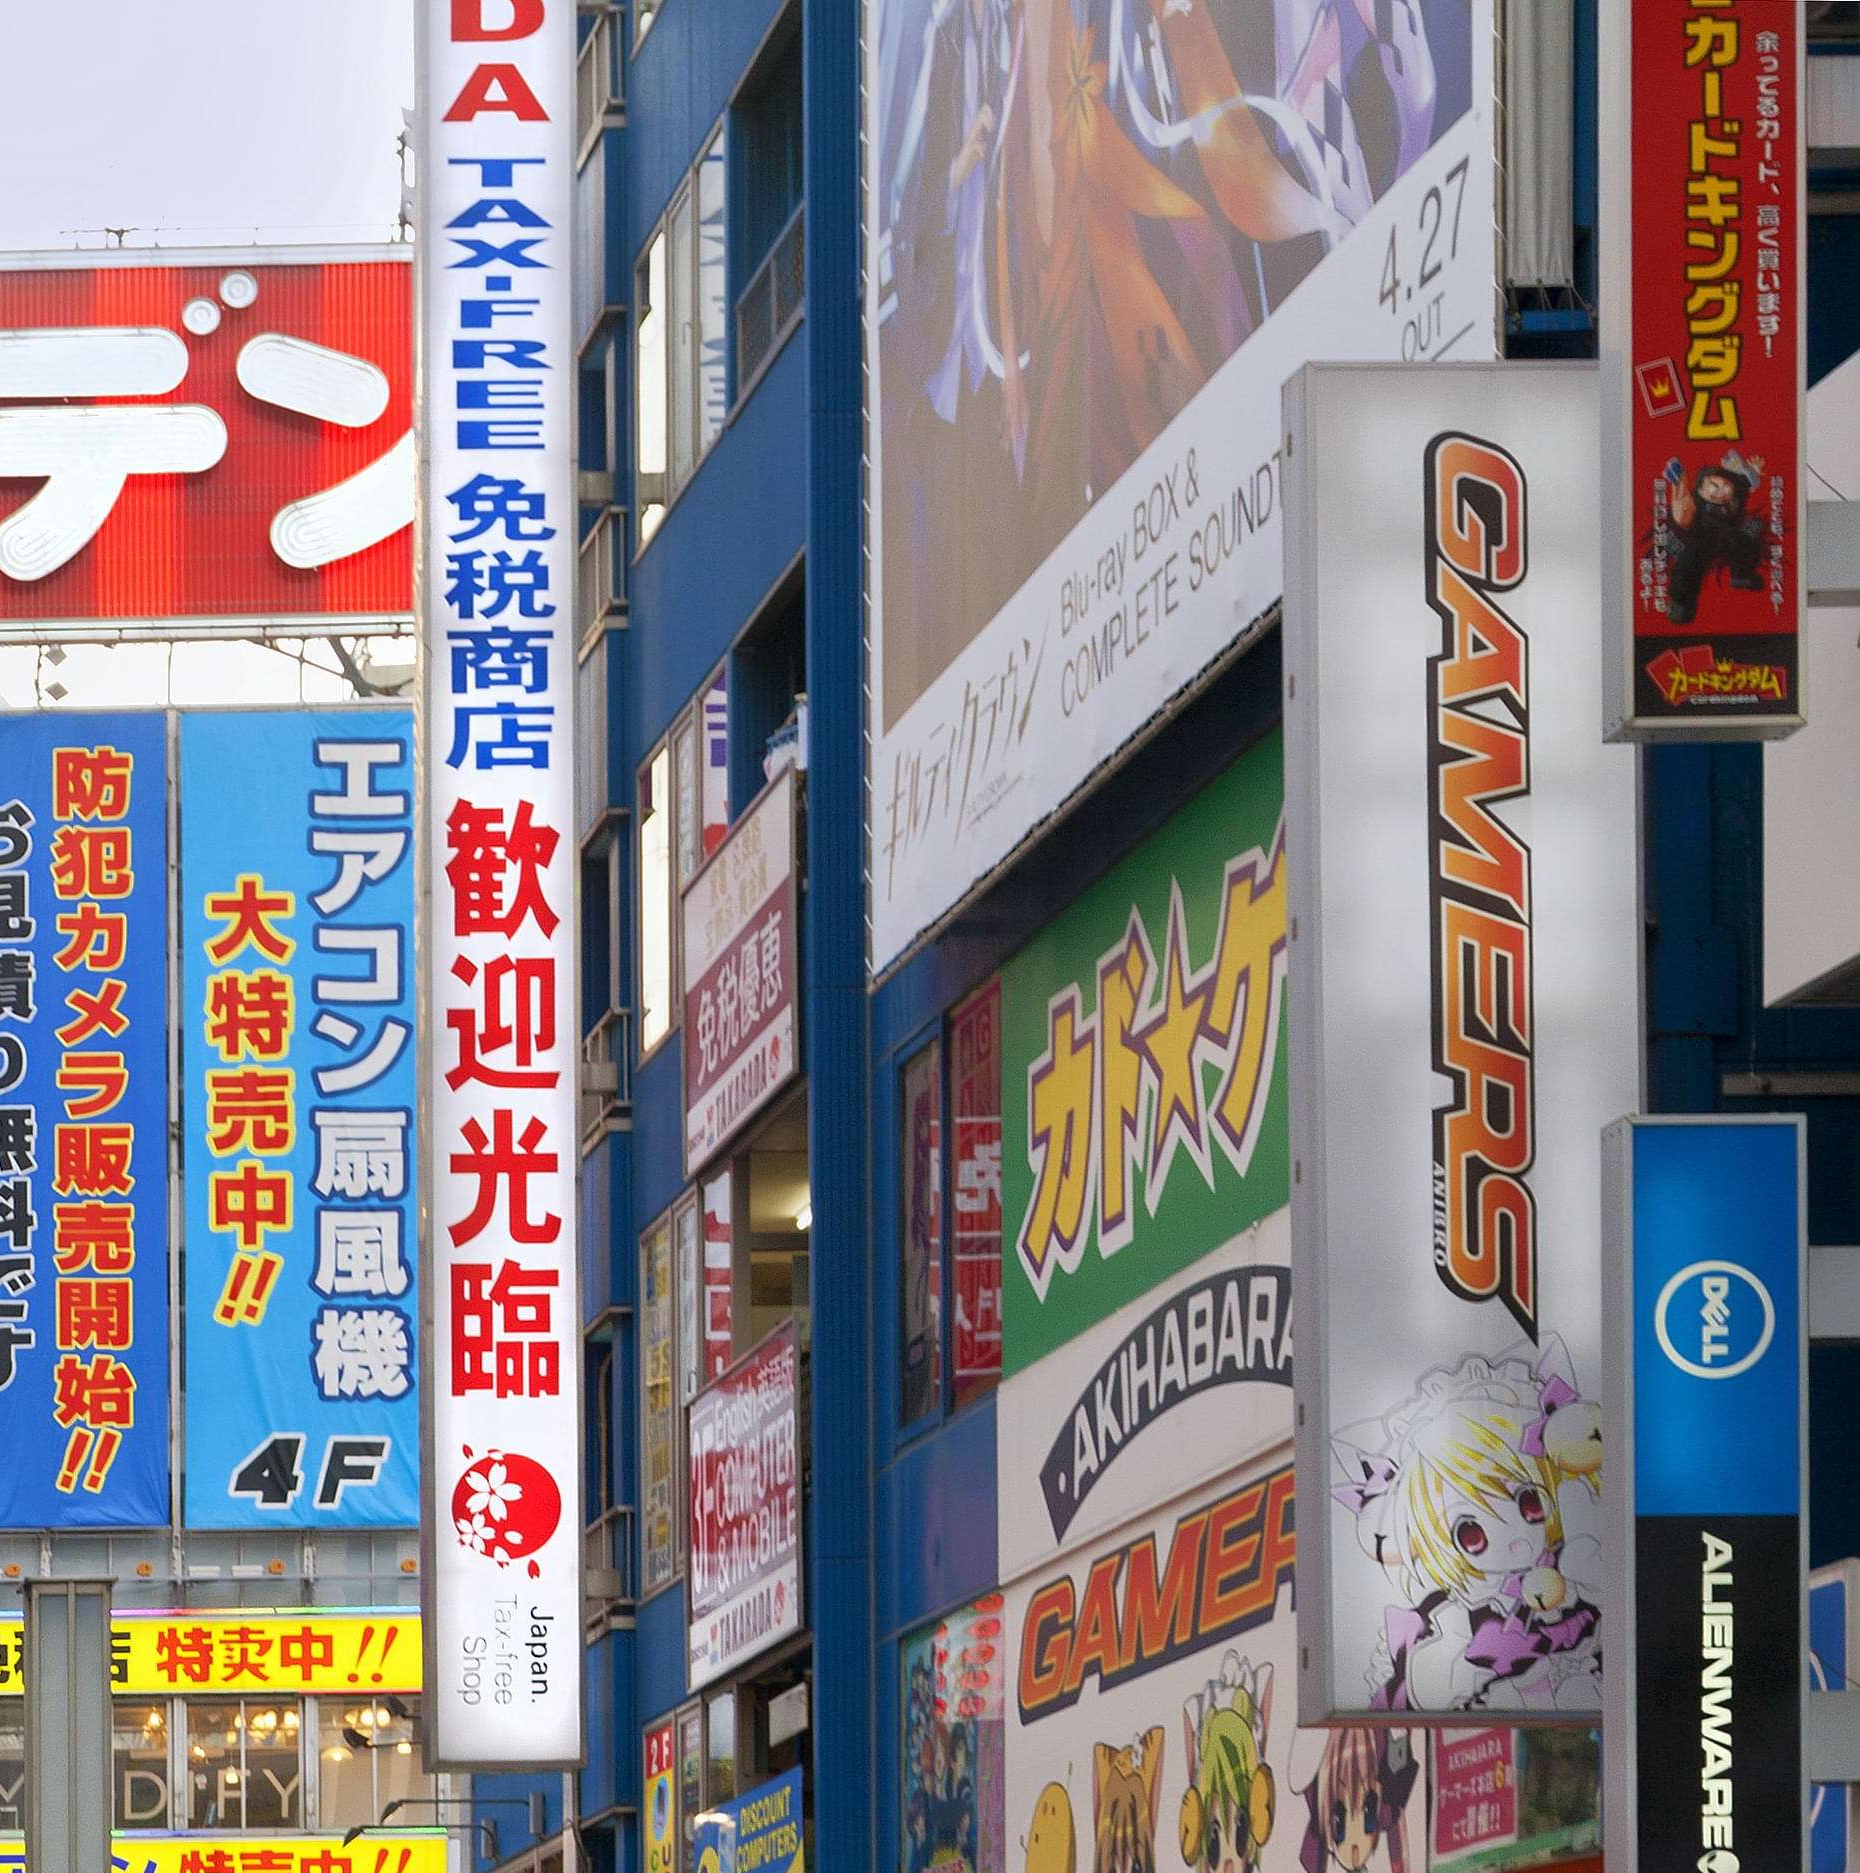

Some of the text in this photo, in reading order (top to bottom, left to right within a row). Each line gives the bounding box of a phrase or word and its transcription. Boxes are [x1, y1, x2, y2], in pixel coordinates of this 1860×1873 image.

[1376, 152, 1472, 313] 4.27
[444, 472, 555, 773] 免税商店
[1059, 446, 1200, 640] Blu-ray BOX &
[1060, 556, 1181, 720] COMPLETE
[1422, 430, 1538, 1344] GAMERS
[306, 735, 415, 1400] エアコン扇風機
[1700, 1273, 1728, 1364] DELL
[231, 1432, 390, 1510] 4F
[714, 1407, 796, 1530] COMPUTER
[731, 1486, 797, 1582] MOBILE
[462, 1593, 515, 1705] Tax-free Shop
[1700, 1531, 1735, 1849] ALIENWARE
[739, 1786, 792, 1838] DISCOUNT
